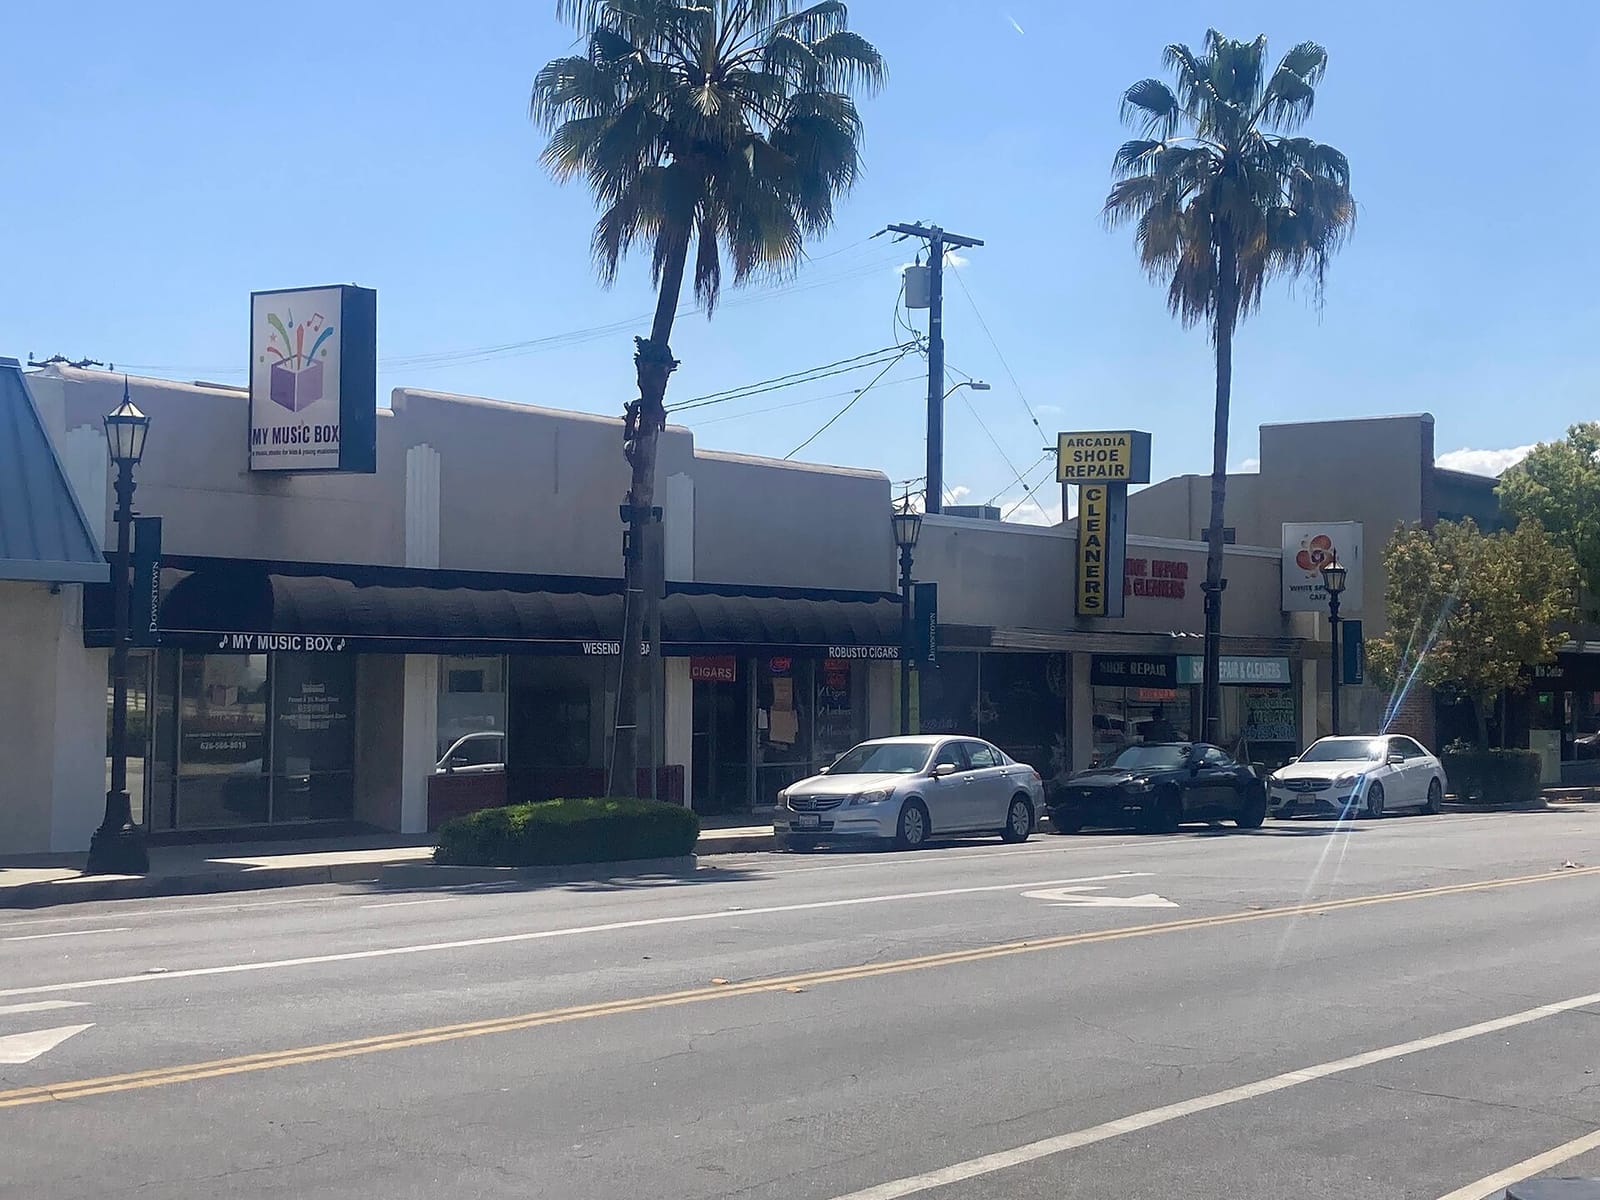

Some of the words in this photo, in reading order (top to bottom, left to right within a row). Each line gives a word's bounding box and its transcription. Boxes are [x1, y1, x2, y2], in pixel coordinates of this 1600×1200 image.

[252, 427, 268, 445] MY
[314, 425, 339, 443] BOX
[1067, 437, 1126, 447] ARCADIA
[1073, 449, 1119, 462] SHOE
[1065, 464, 1125, 478] REPAIR
[1085, 489, 1102, 608] CLEANERS
[1125, 558, 1148, 576] HOE
[1152, 560, 1188, 579] REPAIR
[1133, 578, 1186, 599] CLEANERS
[1289, 584, 1312, 592] WHITE
[232, 634, 254, 649] MY
[257, 635, 301, 650] MUSIC
[305, 636, 334, 651] BOX
[582, 642, 620, 655] WESEND
[828, 646, 868, 658] ROBUSTO
[868, 647, 899, 659] CIGARS
[692, 666, 733, 678] CIGARS
[1099, 661, 1126, 674] SHOE
[1130, 661, 1168, 677] REPAIR
[1193, 661, 1204, 679] SH
[1218, 661, 1239, 679] EPAIR
[1247, 662, 1282, 679] CLEANERS
